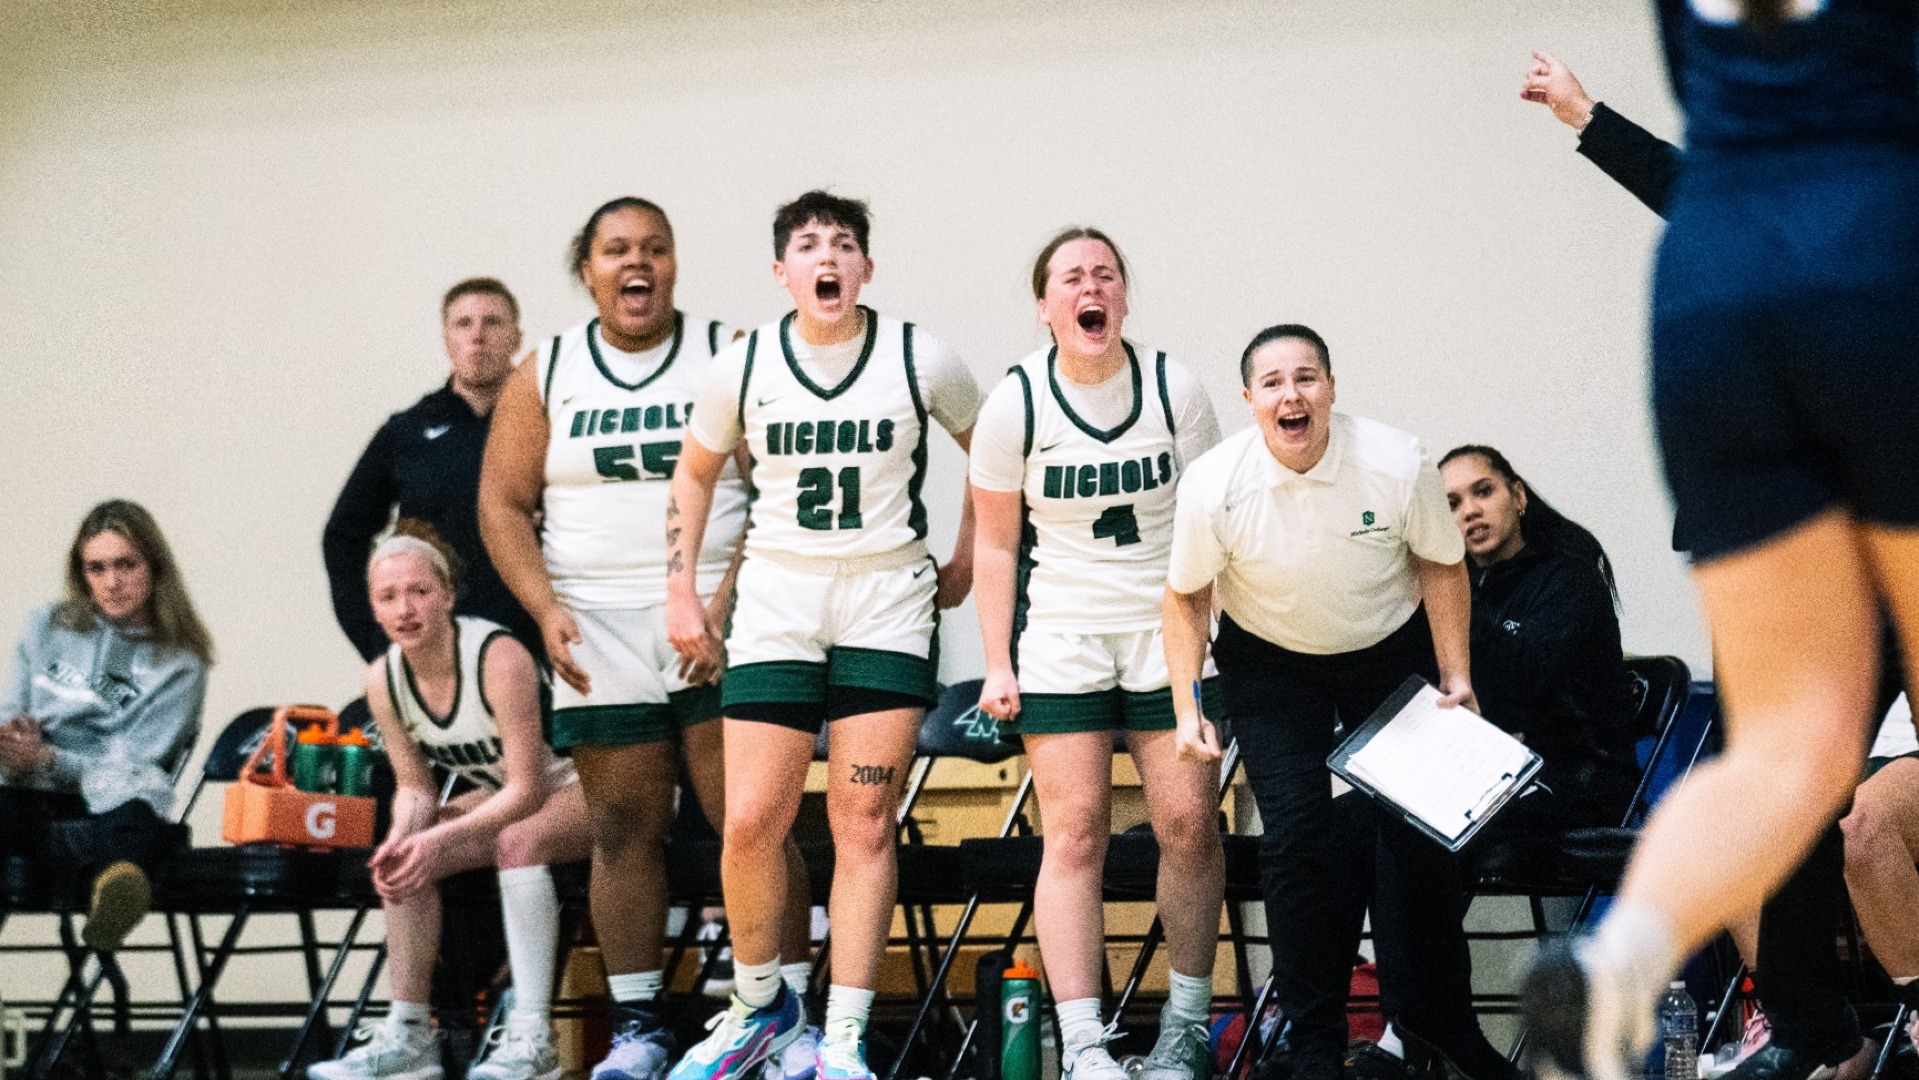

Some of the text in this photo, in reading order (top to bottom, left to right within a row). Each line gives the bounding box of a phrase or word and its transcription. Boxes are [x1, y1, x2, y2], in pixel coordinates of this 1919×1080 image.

[766, 419, 895, 455] NICHOLS
[593, 440, 683, 482] 55
[1043, 451, 1172, 499] NICHOLS
[797, 467, 863, 530] 21
[1092, 504, 1142, 547] 4
[851, 764, 896, 785] 2004
[305, 802, 336, 839] G
[1006, 996, 1030, 1024] G
